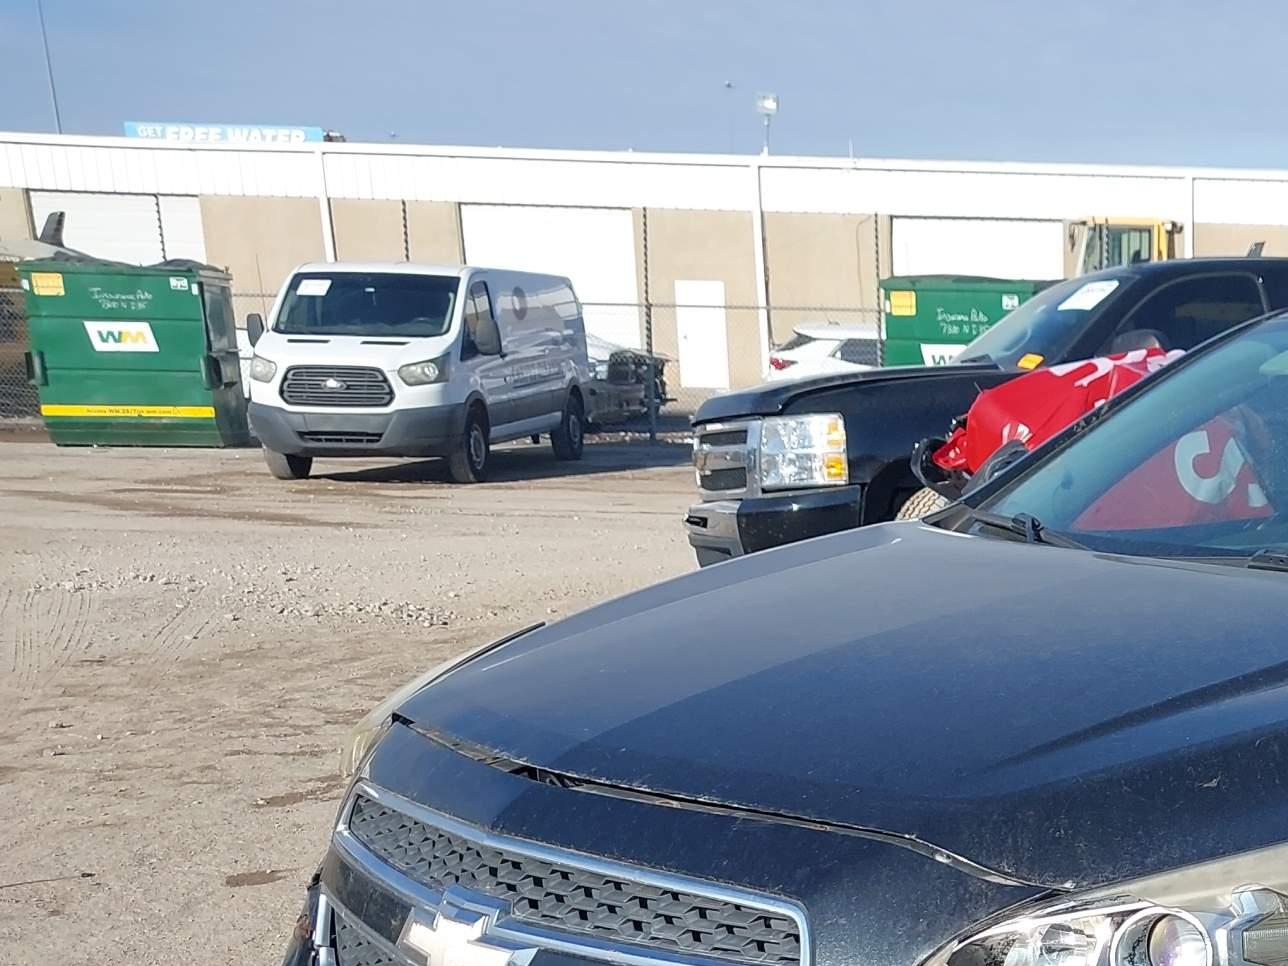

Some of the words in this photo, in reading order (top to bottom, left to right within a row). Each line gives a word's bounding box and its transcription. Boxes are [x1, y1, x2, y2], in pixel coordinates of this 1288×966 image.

[137, 125, 163, 138] GET
[165, 126, 223, 142] FREE
[226, 127, 306, 143] WATER
[97, 330, 148, 344] WM
